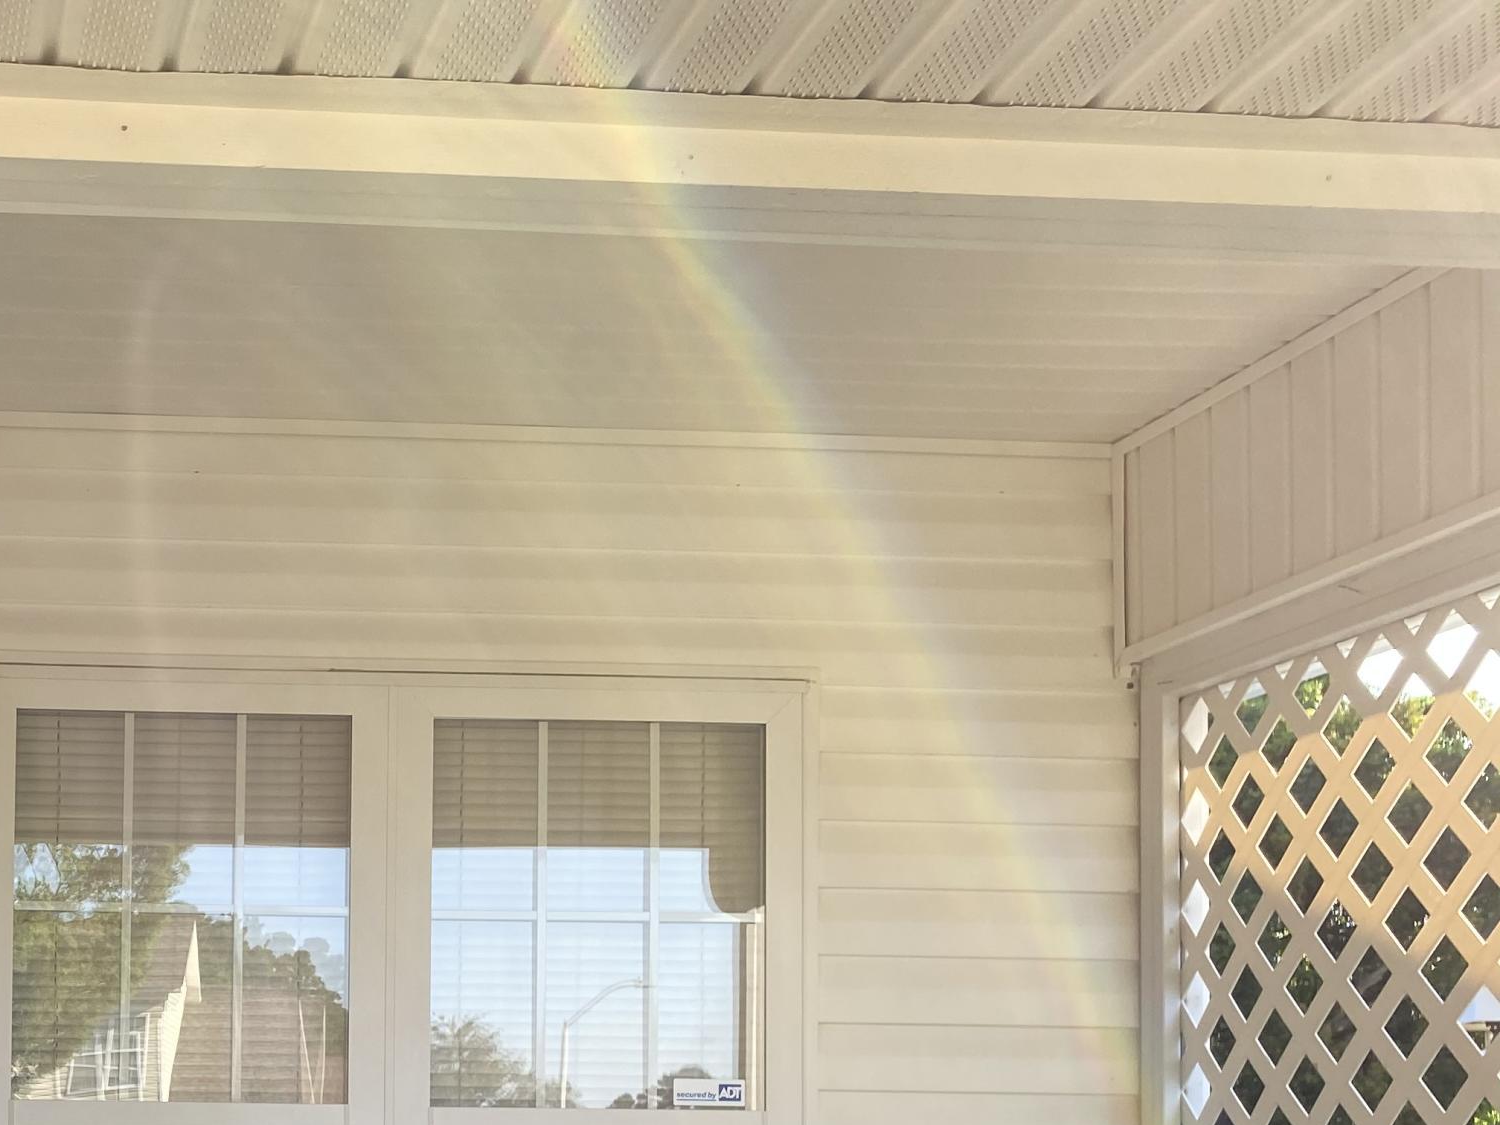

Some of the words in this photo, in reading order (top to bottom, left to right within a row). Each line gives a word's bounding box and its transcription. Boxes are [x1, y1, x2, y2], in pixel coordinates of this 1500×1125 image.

[676, 1091, 707, 1099] secured
[707, 1091, 717, 1100] by
[719, 1086, 741, 1099] ADT
